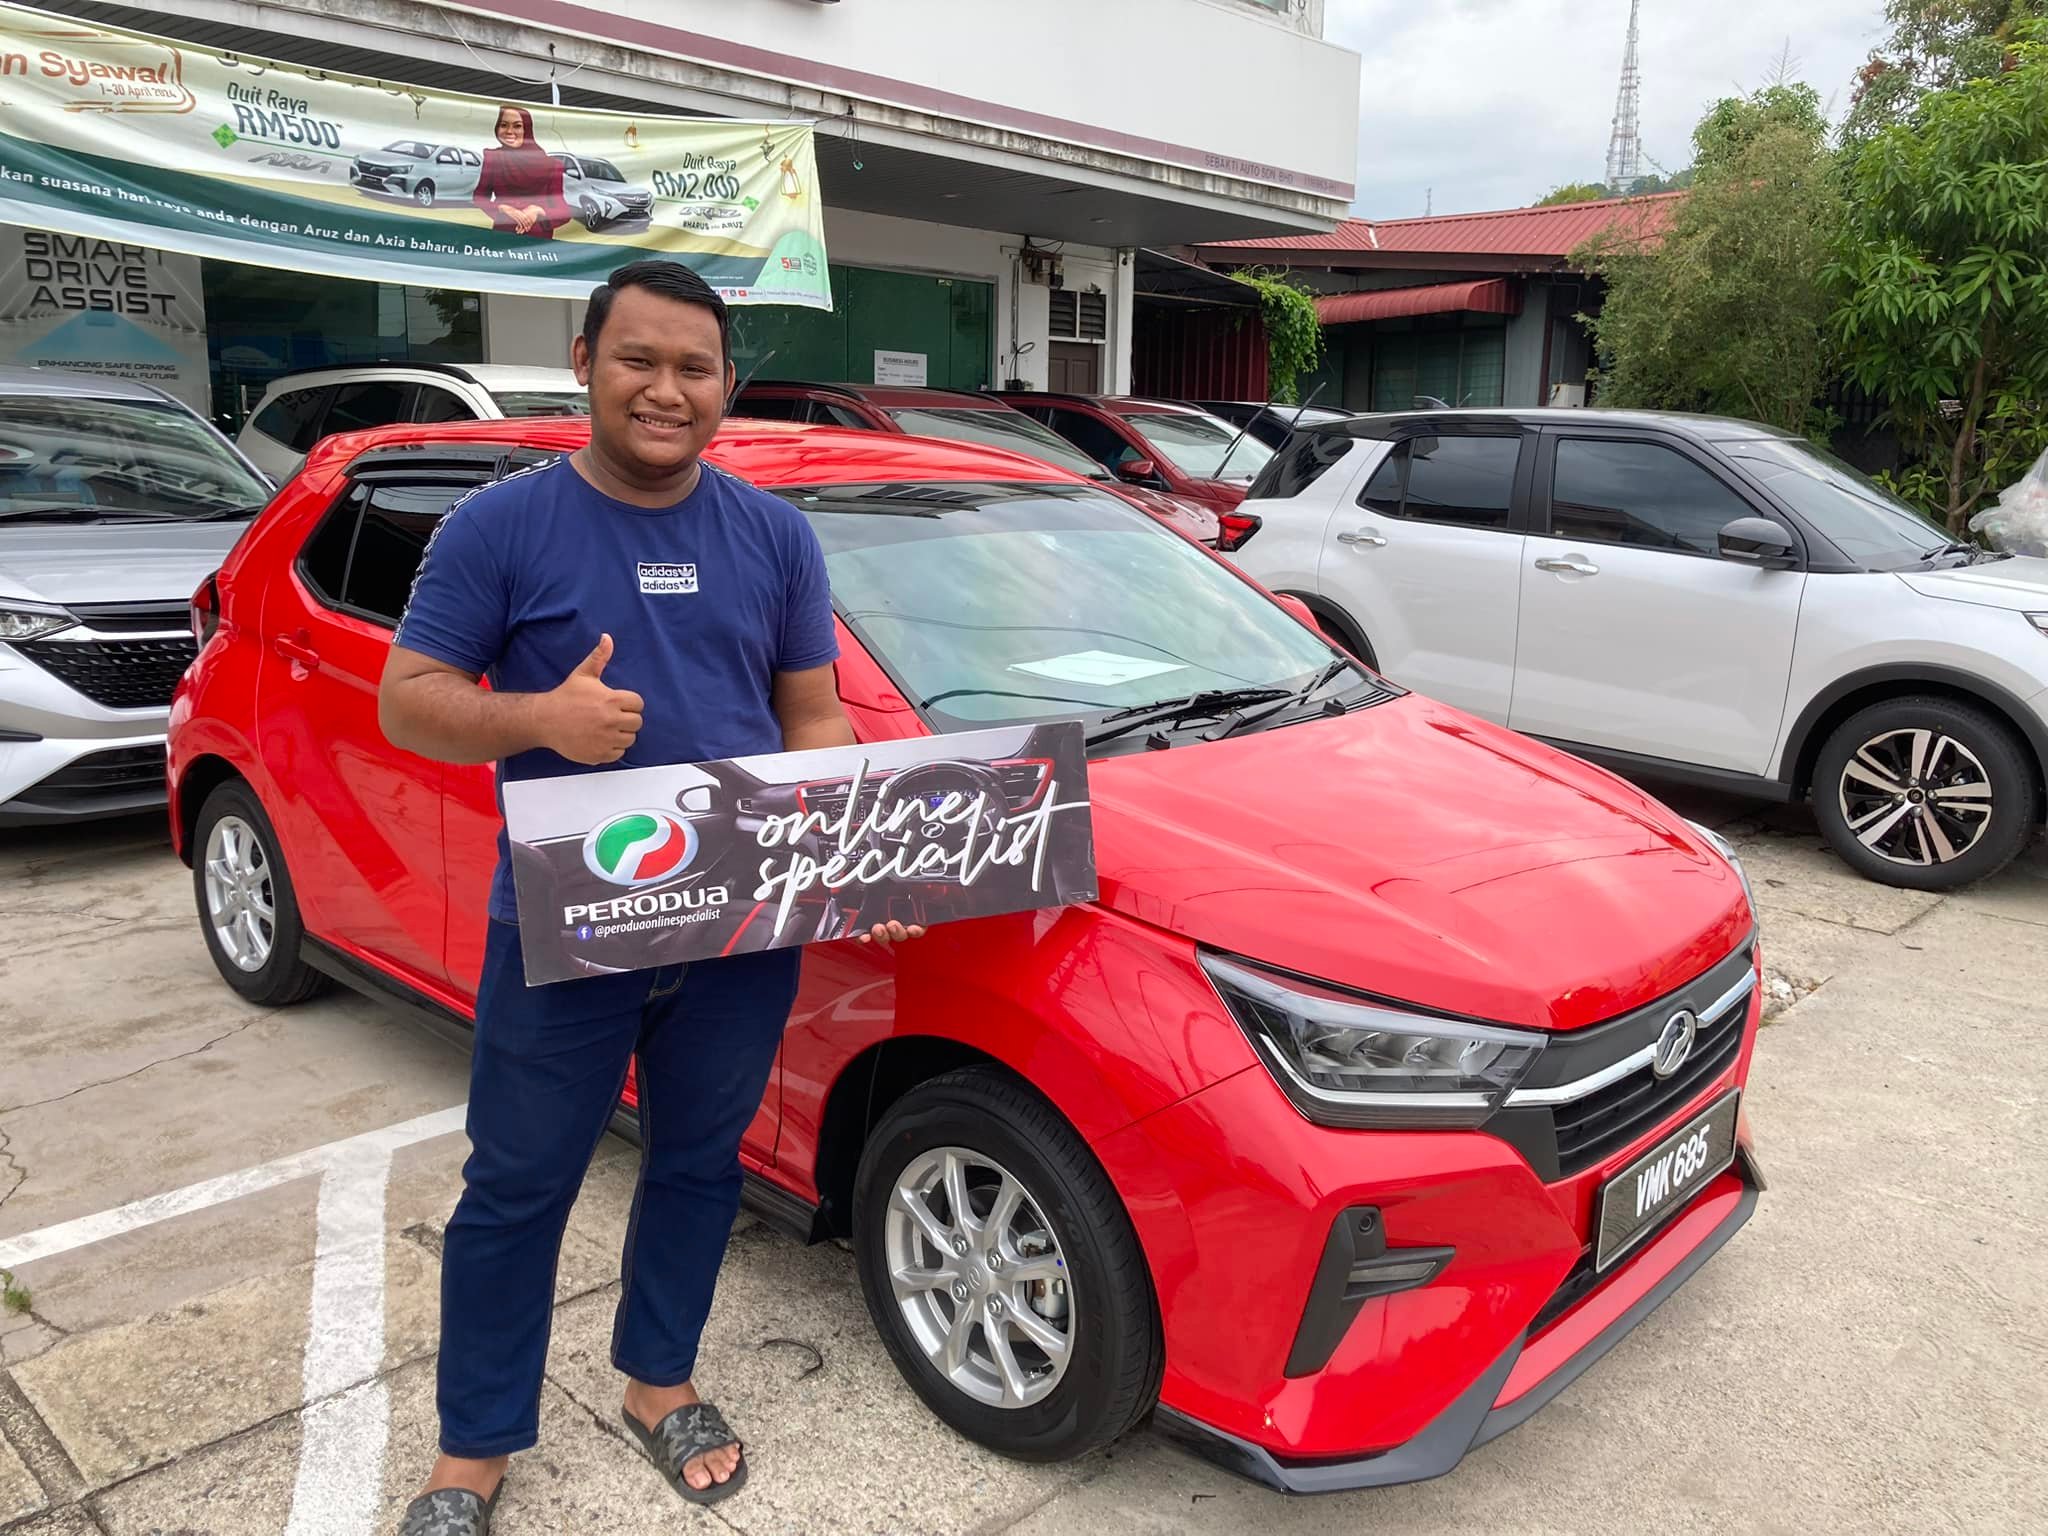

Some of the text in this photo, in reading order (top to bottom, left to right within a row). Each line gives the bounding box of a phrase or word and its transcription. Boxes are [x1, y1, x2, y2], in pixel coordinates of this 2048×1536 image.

[40, 52, 168, 86] Syawal
[128, 85, 151, 99] April
[227, 81, 308, 114] Duit Raya
[683, 152, 737, 174] Duit Raya
[1204, 154, 1239, 172] SEBAKTI
[1239, 162, 1260, 177] AUTO
[41, 176, 111, 197] suasana
[117, 187, 150, 205] hari
[197, 209, 234, 223] anda
[240, 213, 298, 234] dengan
[304, 224, 339, 239] Aruz
[344, 228, 370, 243] dan
[375, 233, 406, 248] Axia
[410, 237, 459, 255] baharu.
[464, 244, 504, 259] Daftar
[508, 249, 533, 262] hari
[537, 252, 559, 262] ini!
[26, 257, 148, 289] DRIVE
[30, 285, 176, 316] ASSIST
[38, 359, 176, 371] ENHANCING SAFE DRIVING
[140, 372, 180, 381] FUTURE
[640, 566, 679, 577] adidas
[642, 580, 680, 591] adidas
[756, 758, 977, 854] online
[753, 780, 1090, 937] specialist
[595, 908, 721, 938] @peroduaonlinespecialist
[1636, 1124, 1711, 1217] VMK 685
